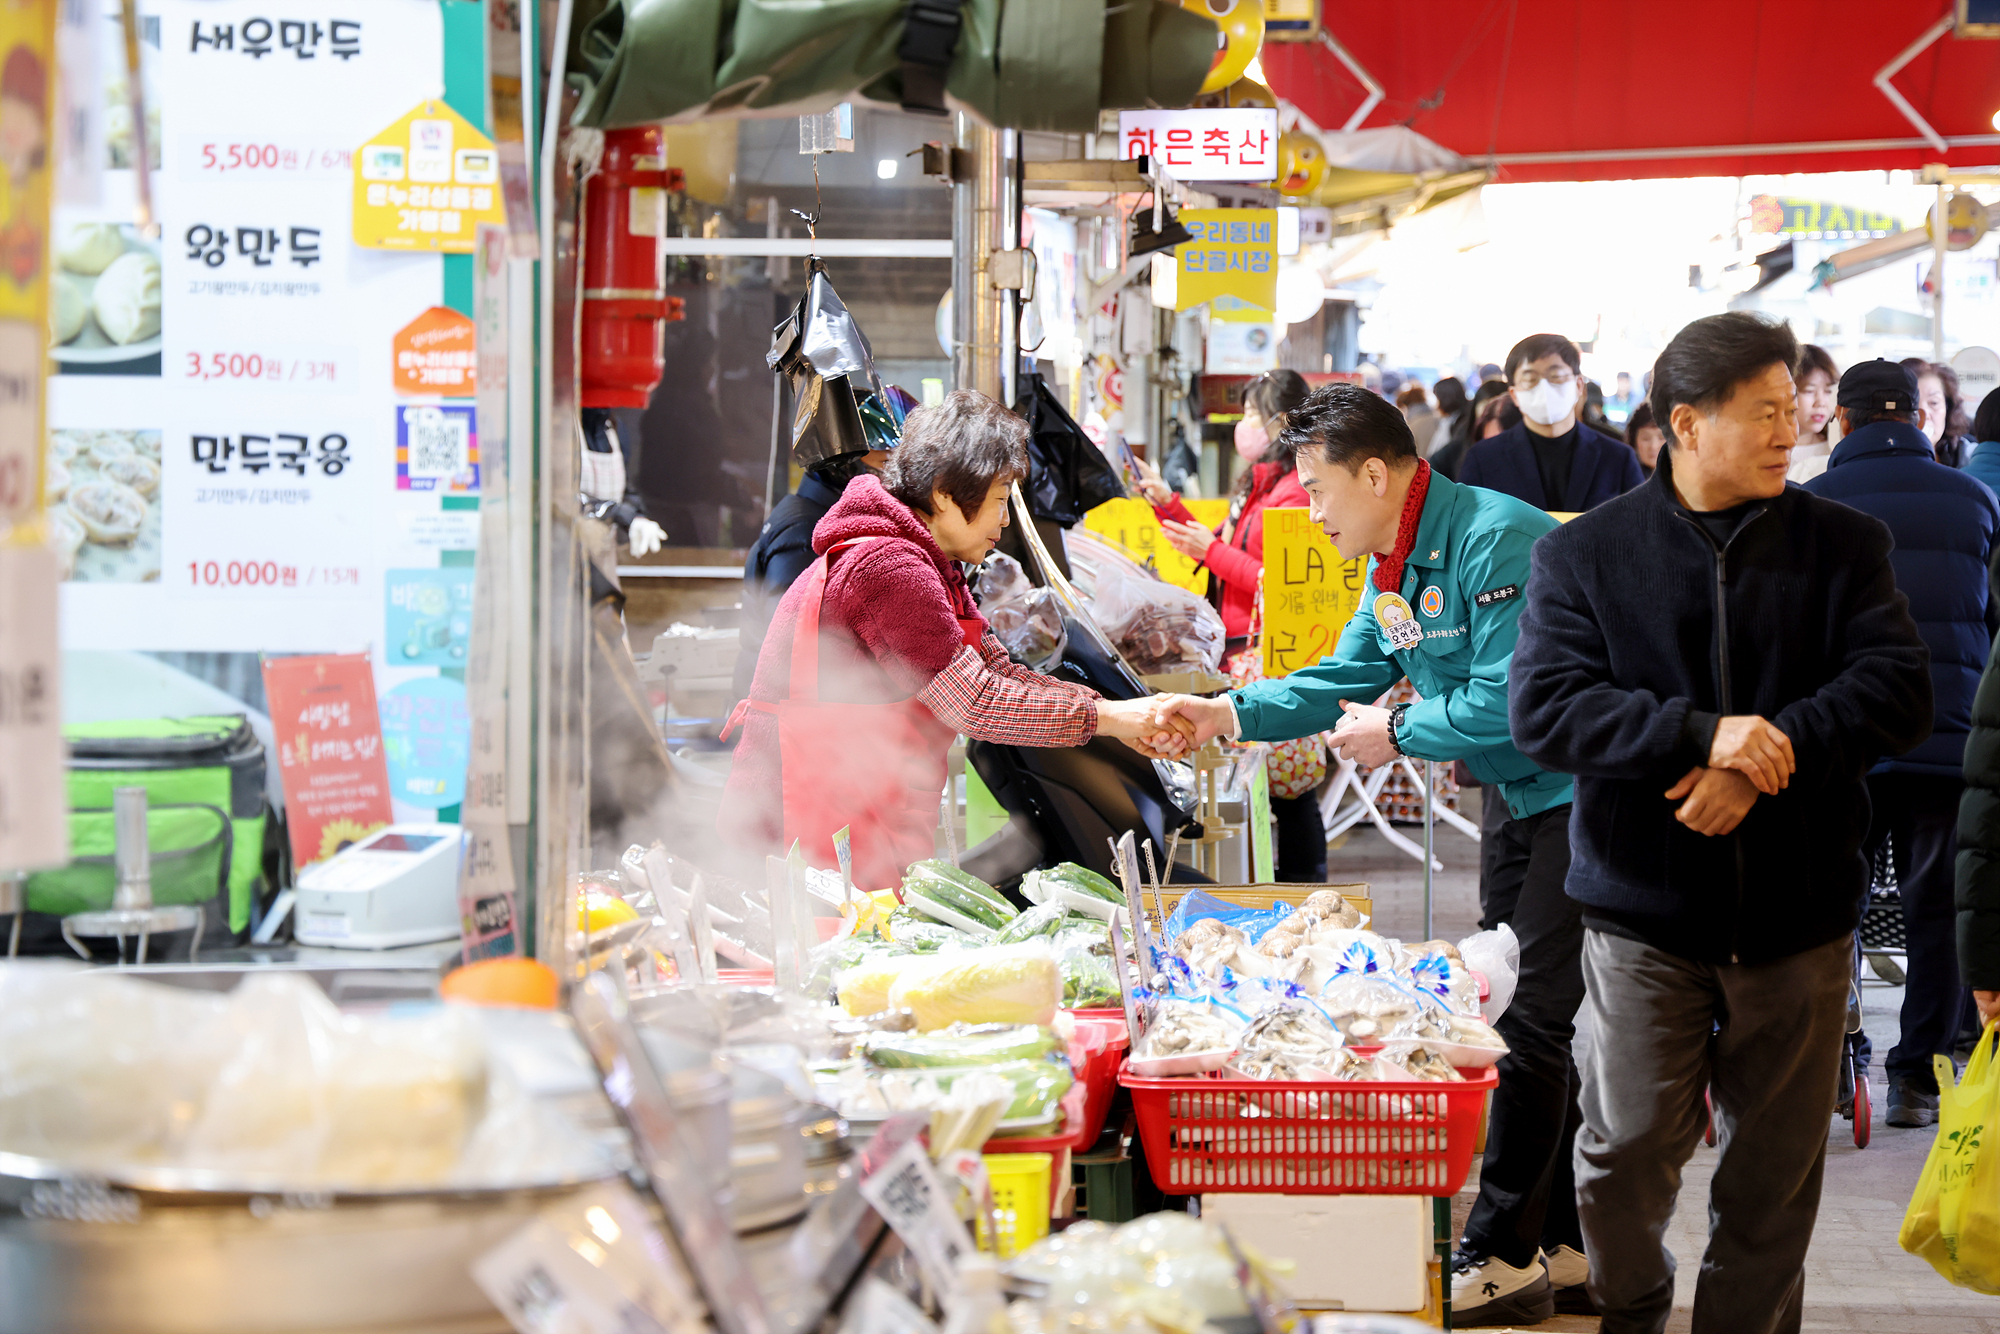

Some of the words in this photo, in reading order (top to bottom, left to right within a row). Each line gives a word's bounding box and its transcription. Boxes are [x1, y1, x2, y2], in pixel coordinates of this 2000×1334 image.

[190, 17, 361, 60] 새우만두
[202, 144, 298, 172] 5,500원
[1128, 128, 1269, 165] 하은축산
[186, 224, 321, 268] 왕만두
[1186, 221, 1272, 243] 우리동네
[1185, 251, 1272, 273] 단골시장
[186, 352, 282, 381] 3,500원
[306, 360, 336, 381] 3개
[191, 433, 351, 476] 만두국용
[188, 561, 298, 587] 10,000원
[1284, 547, 1325, 586] LA
[1478, 593, 1491, 604] 서울
[1493, 587, 1515, 600] 도봉구
[1392, 627, 1419, 644] 오언석
